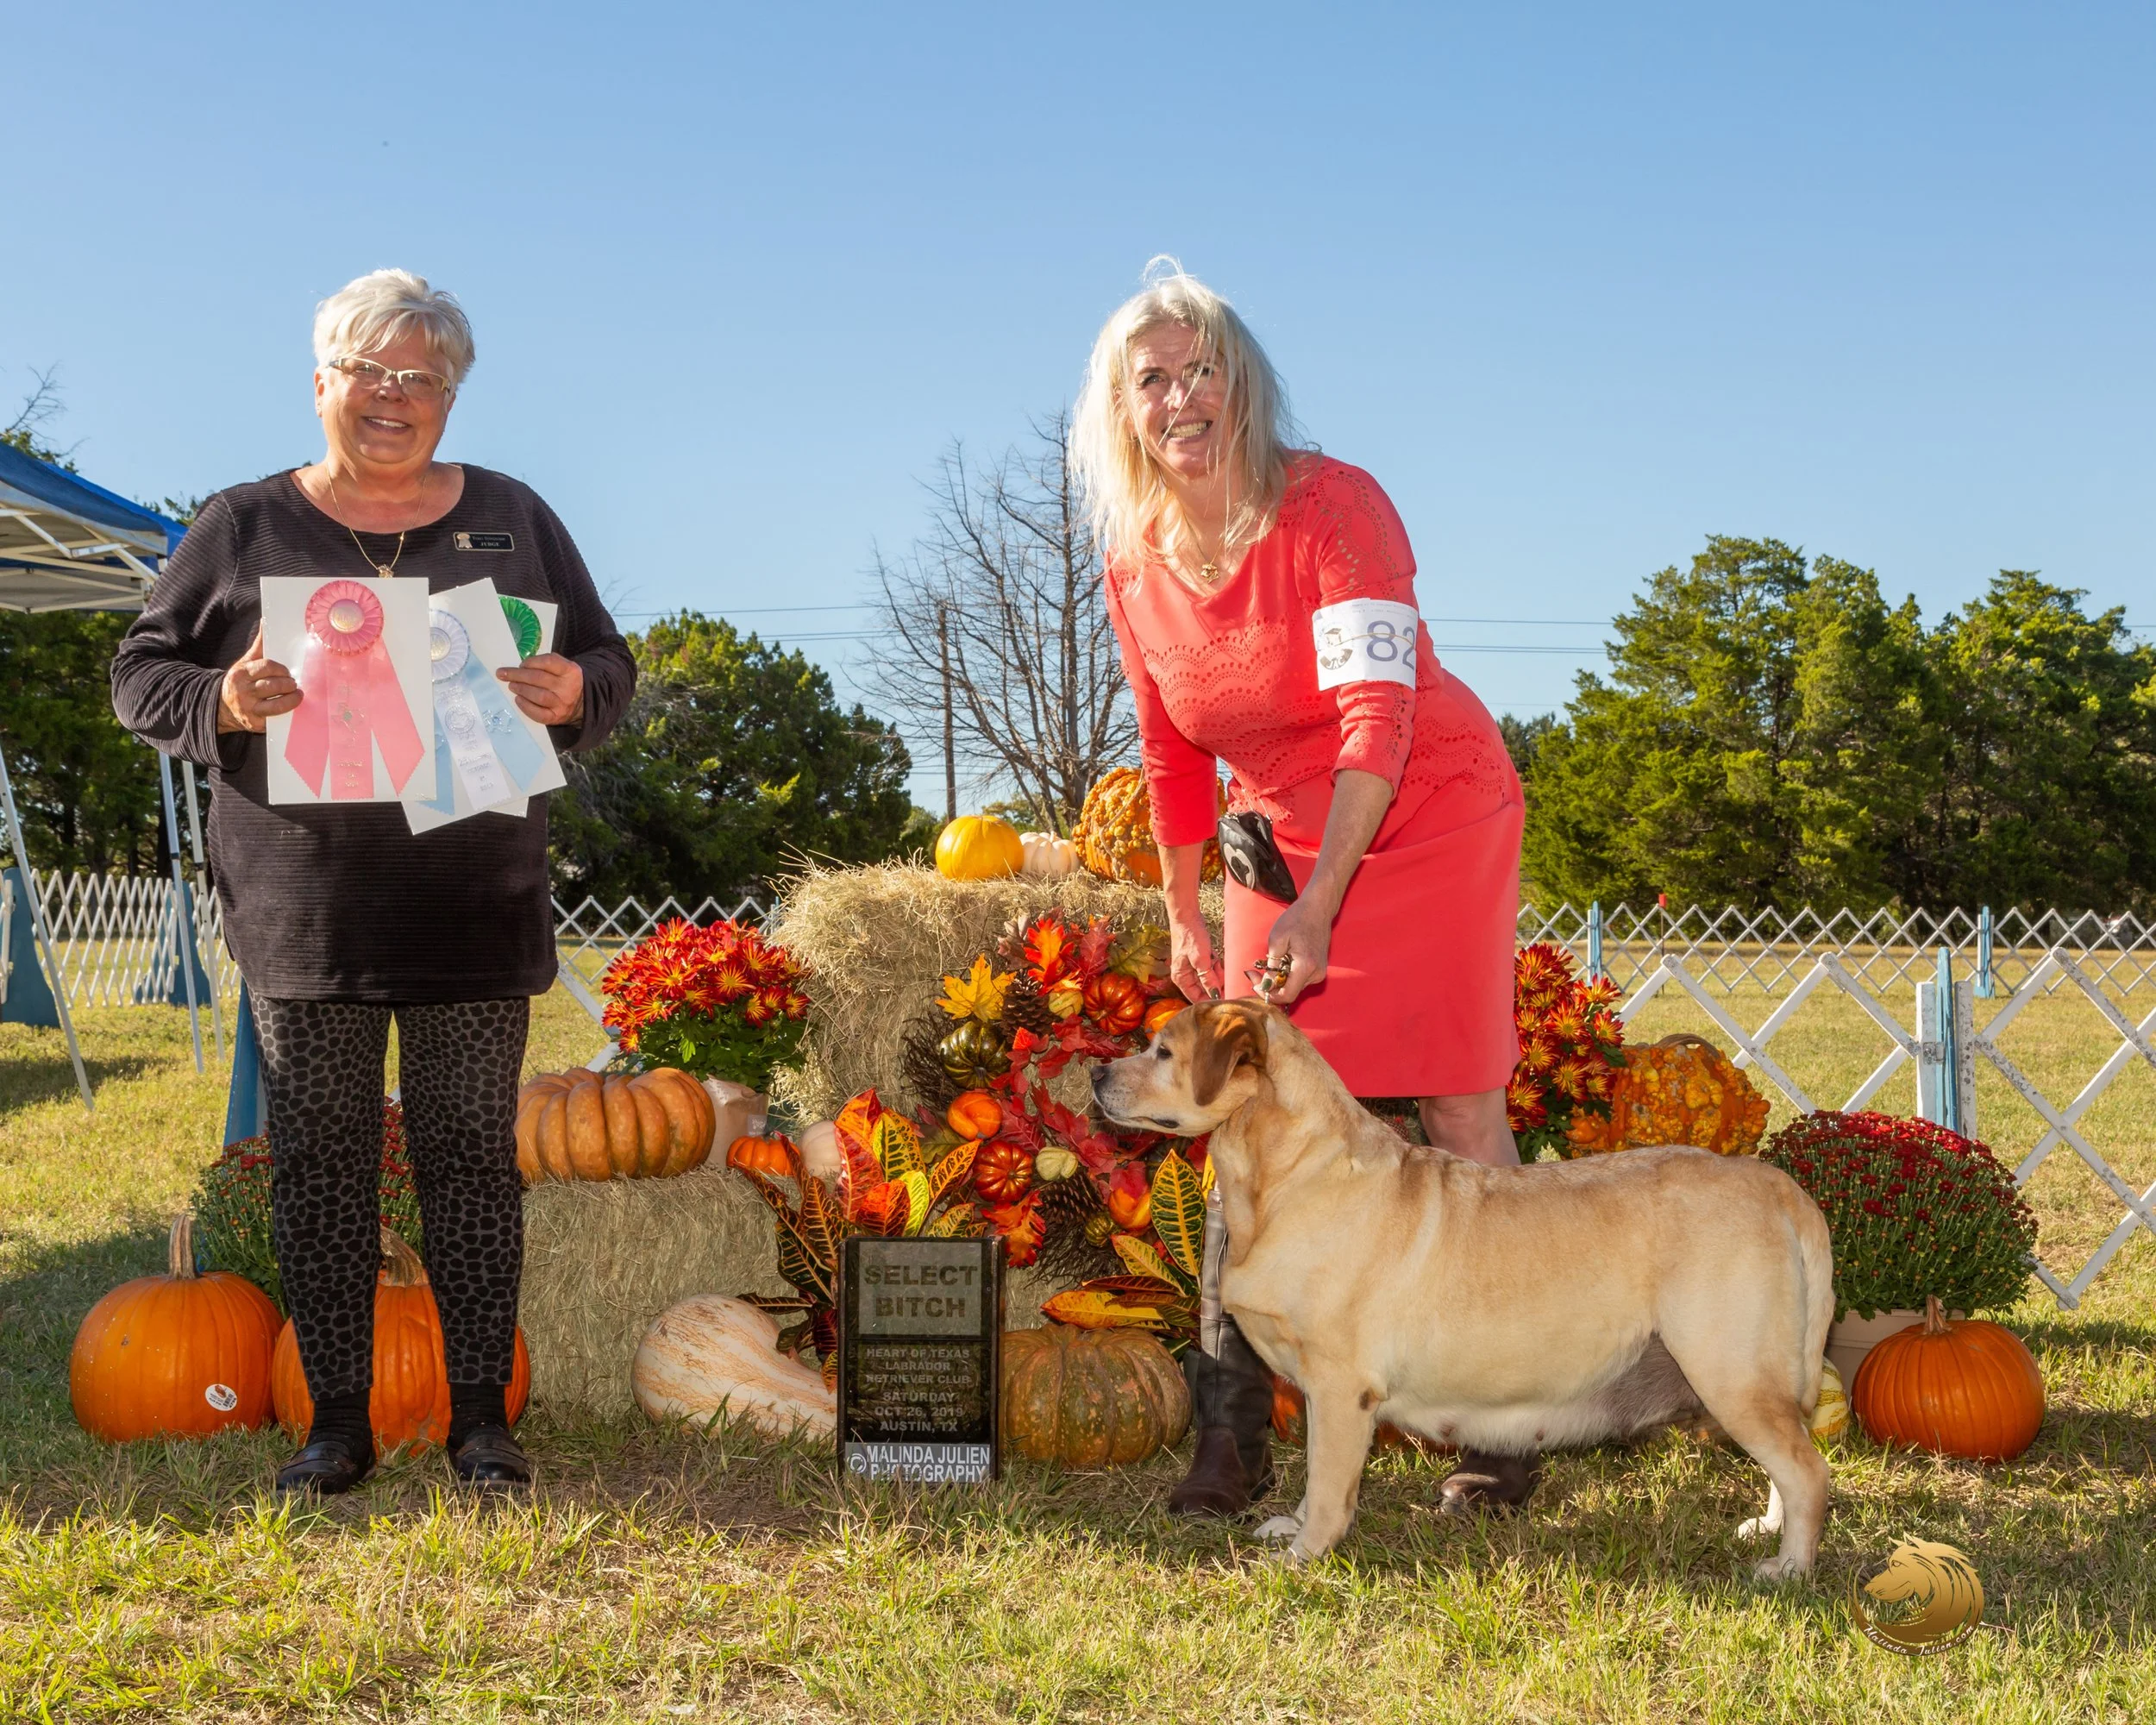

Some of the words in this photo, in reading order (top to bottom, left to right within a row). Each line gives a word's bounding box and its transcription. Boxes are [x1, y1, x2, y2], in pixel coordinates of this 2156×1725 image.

[864, 1264, 978, 1286] SELECT
[875, 1296, 966, 1318] BITCH
[866, 1348, 906, 1358] HEART
[910, 1348, 927, 1358] OF
[931, 1348, 970, 1358] TEXAS
[885, 1361, 951, 1371] LABRADOR
[866, 1374, 933, 1383] RETRIEVER
[937, 1375, 970, 1384] CLUB
[882, 1391, 956, 1402] SATURDAY
[874, 1406, 903, 1416] OCT
[906, 1407, 927, 1418] 26,
[931, 1407, 963, 1417] 2019
[880, 1421, 936, 1433] AUSTIN,
[940, 1421, 958, 1432] TX
[867, 1445, 935, 1464] MALINDA
[937, 1446, 990, 1465] JULIEN
